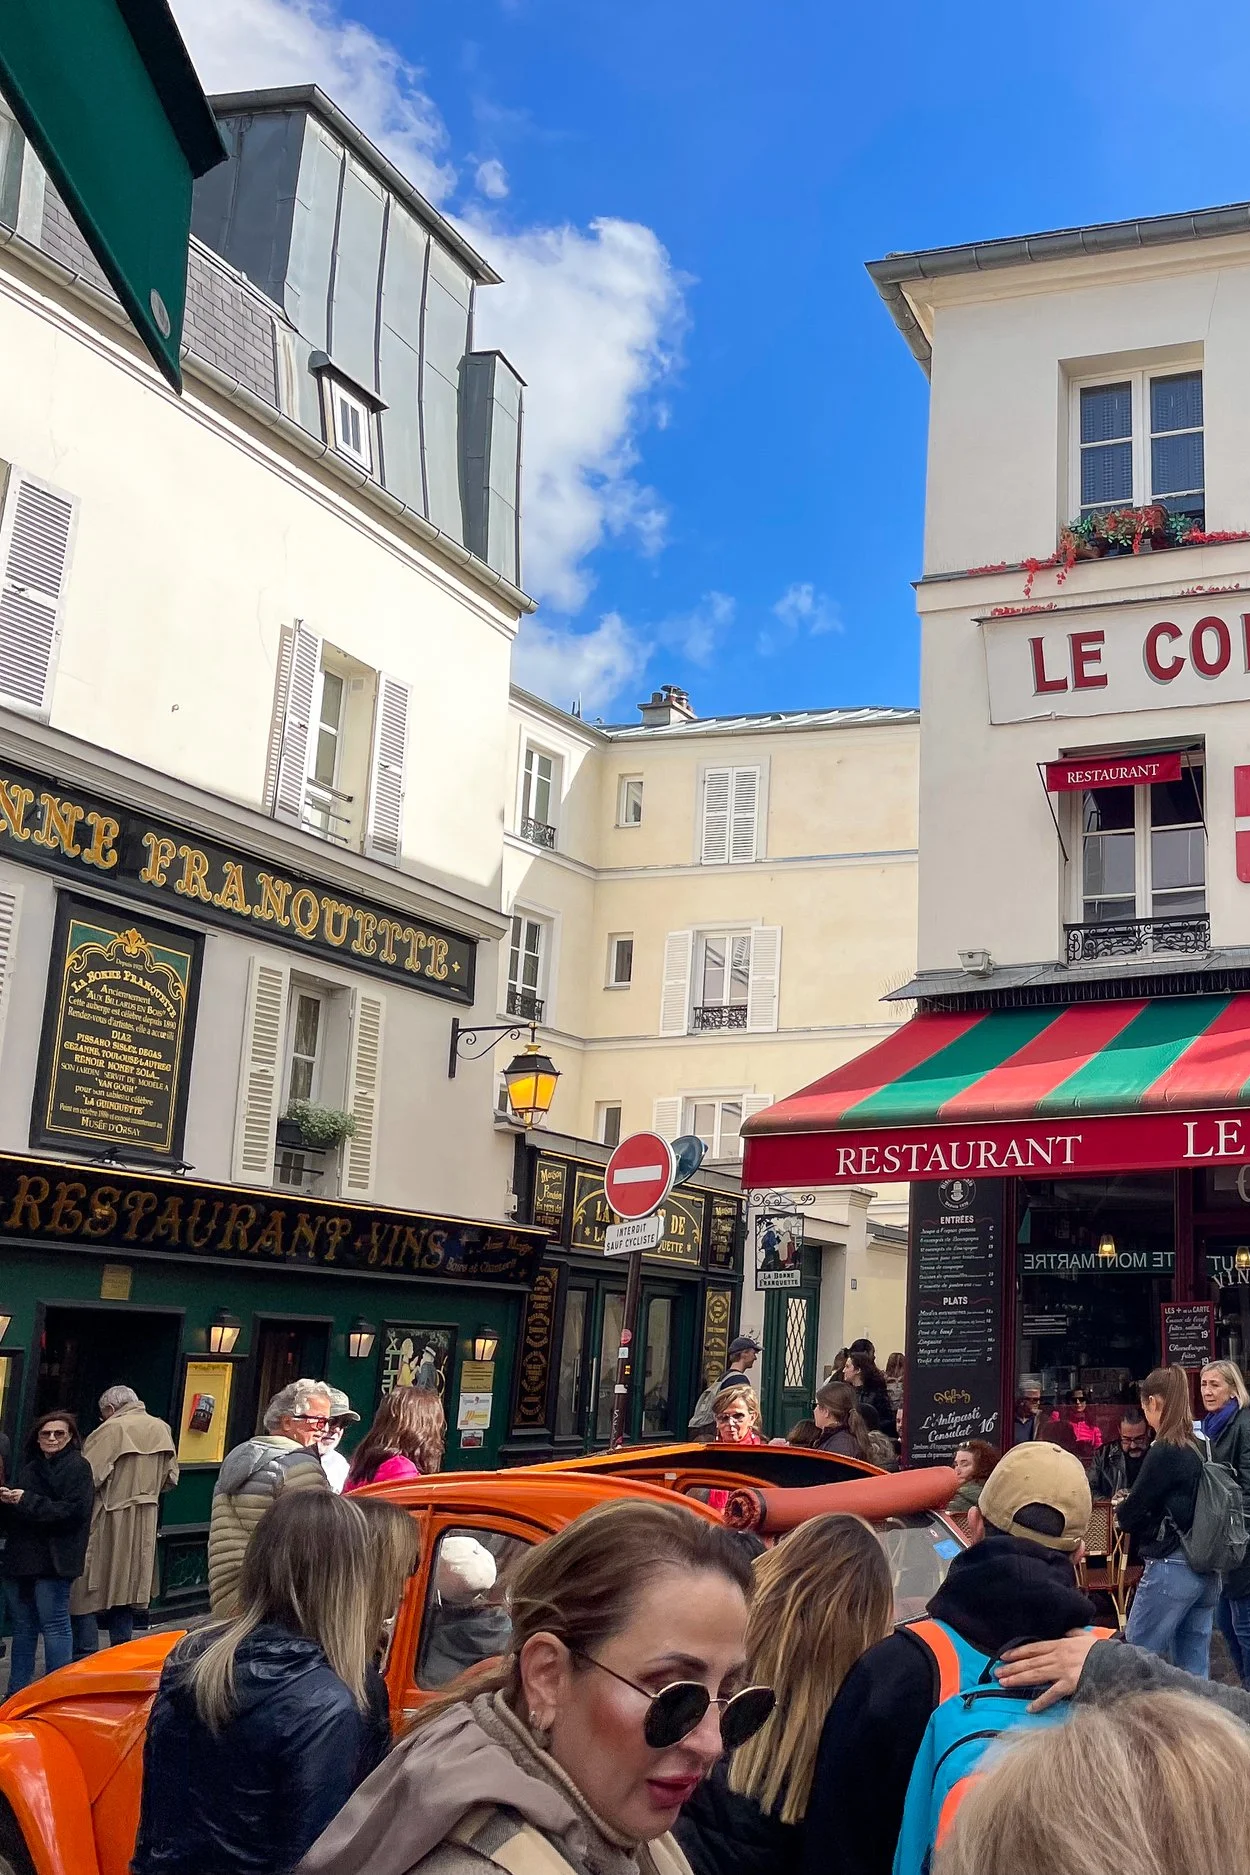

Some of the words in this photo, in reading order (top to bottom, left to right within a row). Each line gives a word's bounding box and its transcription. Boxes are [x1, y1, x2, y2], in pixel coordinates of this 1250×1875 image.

[1030, 630, 1107, 695] LE
[1066, 762, 1160, 785] RESTAURANT
[140, 832, 450, 980] FRANQUETTE
[87, 970, 121, 984] BONNE
[123, 970, 177, 1018] FRANQUETTE
[100, 984, 151, 1005] Anciennement
[68, 1006, 107, 1024] Rendez-vous
[111, 1030, 132, 1043] DIAZ
[138, 1047, 163, 1060] DEGAS
[61, 1062, 75, 1072] SON
[103, 1071, 126, 1083] SERVIT
[835, 1134, 1083, 1178] RESTAURANT
[1183, 1119, 1245, 1158] LE
[4, 1174, 351, 1262] RESTAURANT
[367, 1222, 448, 1268] VINS
[616, 1223, 647, 1237] INTERDIT
[670, 1214, 686, 1236] DE
[940, 1215, 975, 1225] ENTRÉES
[606, 1240, 623, 1251] SAUF
[624, 1233, 655, 1248] CYCLISTE
[943, 1296, 968, 1306] PLATS
[1164, 1307, 1175, 1315] LES
[1192, 1305, 1211, 1313] CARTE
[928, 1424, 974, 1443] Consulat
